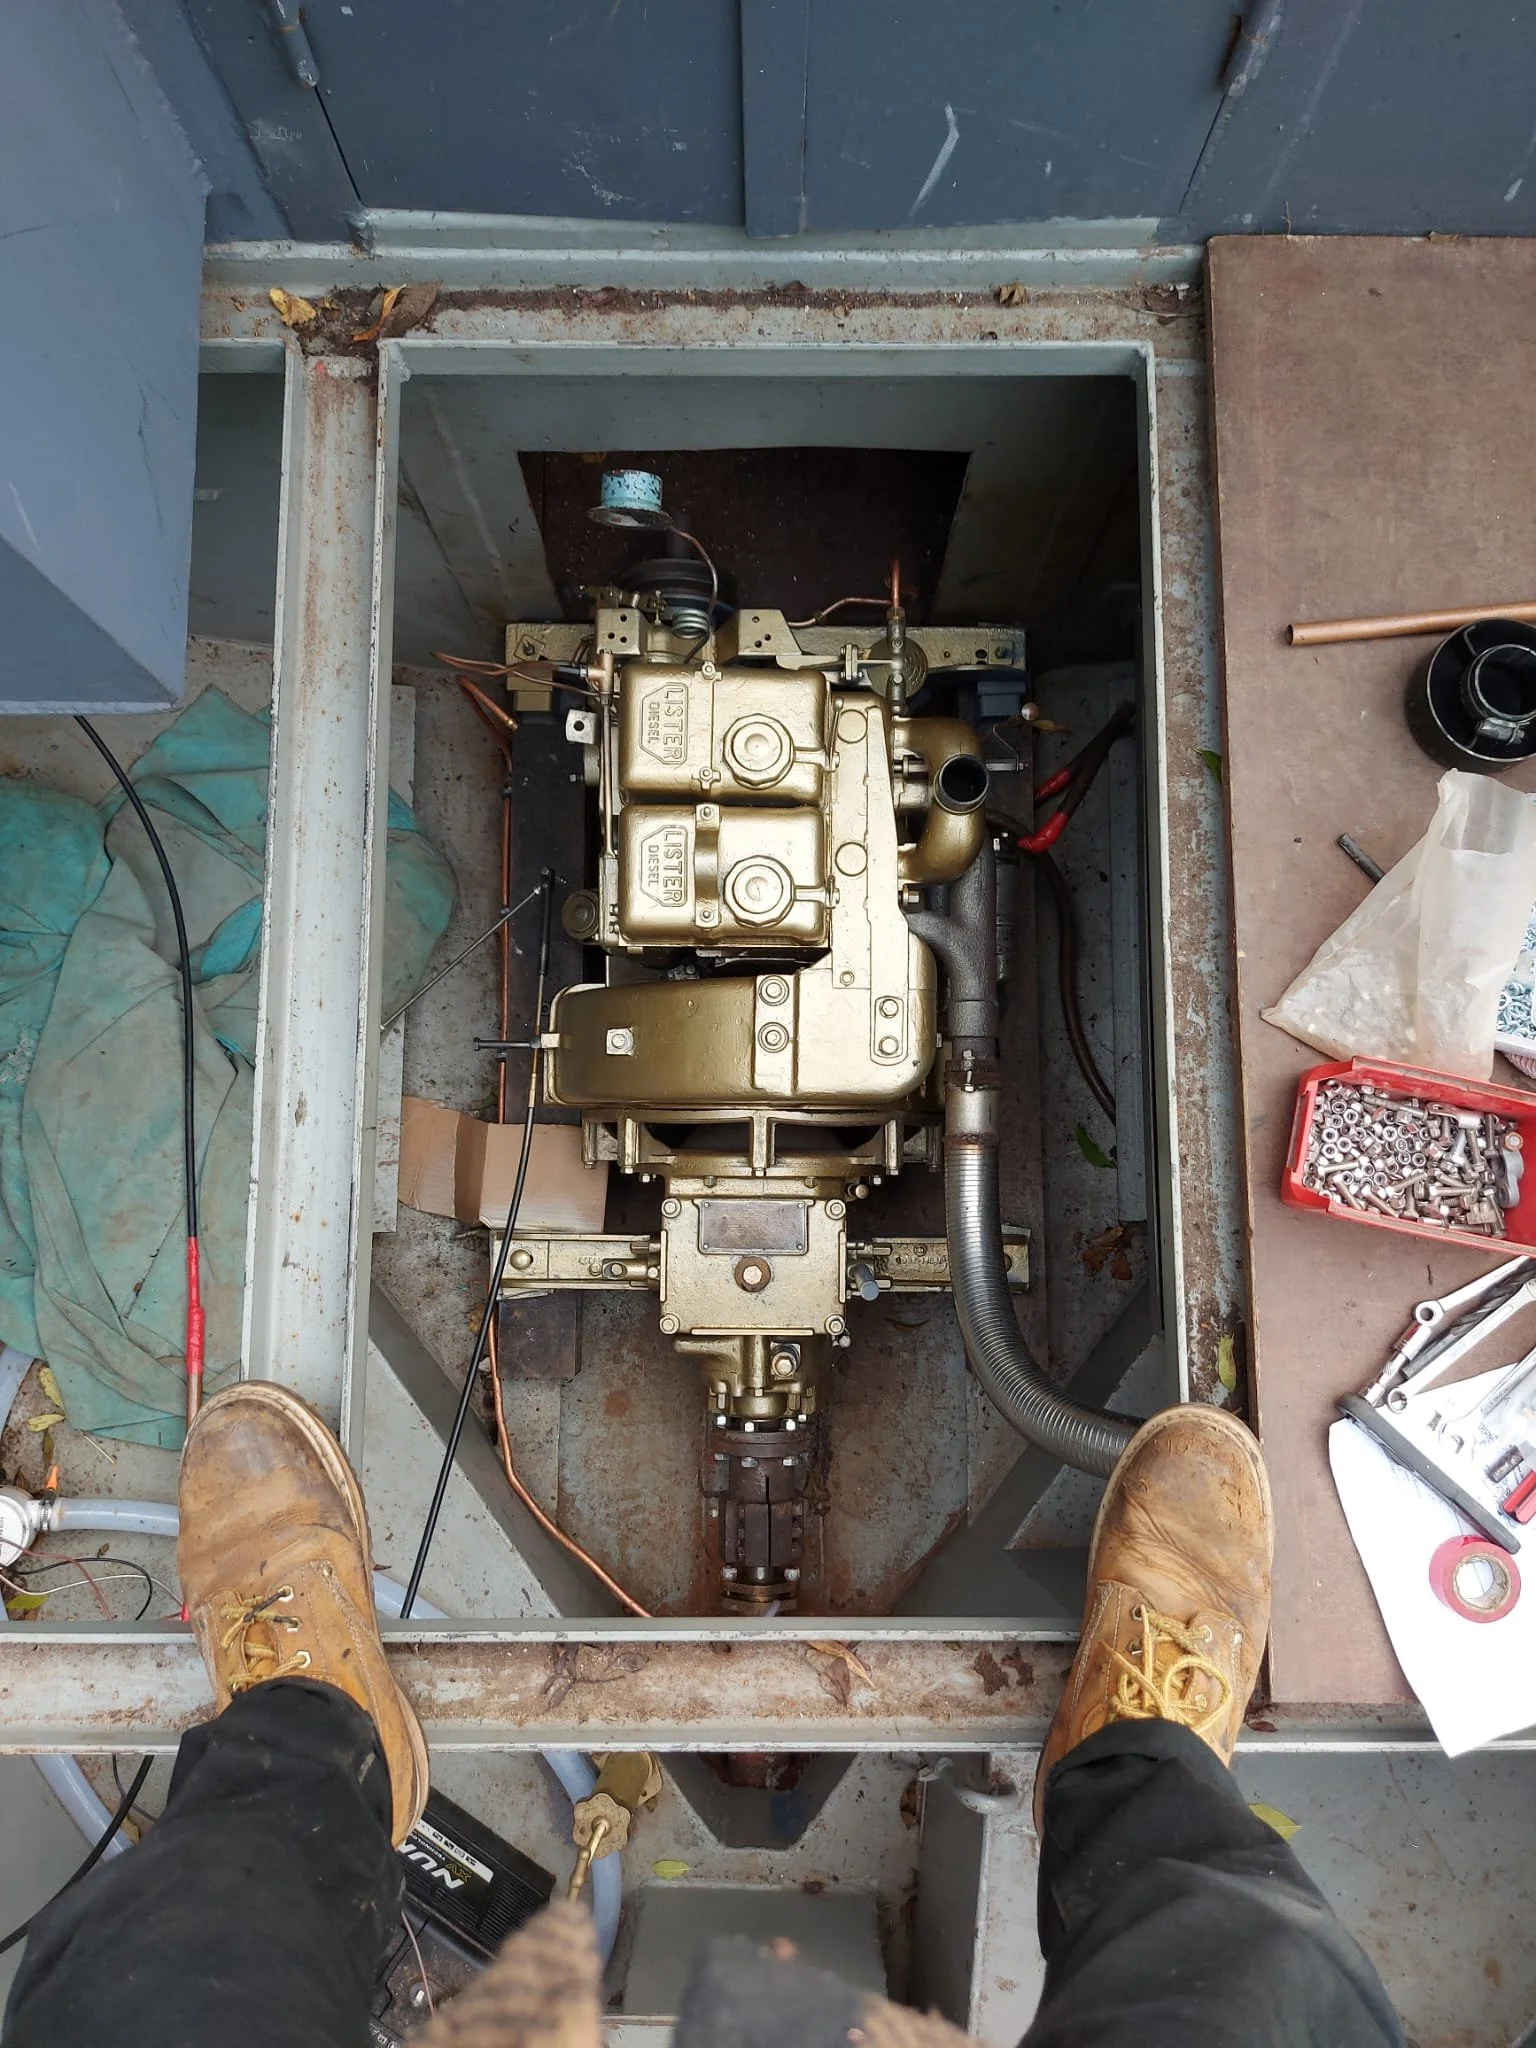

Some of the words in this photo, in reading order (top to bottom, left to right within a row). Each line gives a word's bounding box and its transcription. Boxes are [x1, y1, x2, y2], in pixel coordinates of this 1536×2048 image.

[647, 702, 660, 744] DIESEL
[663, 687, 684, 762] LISTER
[647, 844, 660, 887] DIESEL
[663, 829, 684, 904] LISTER
